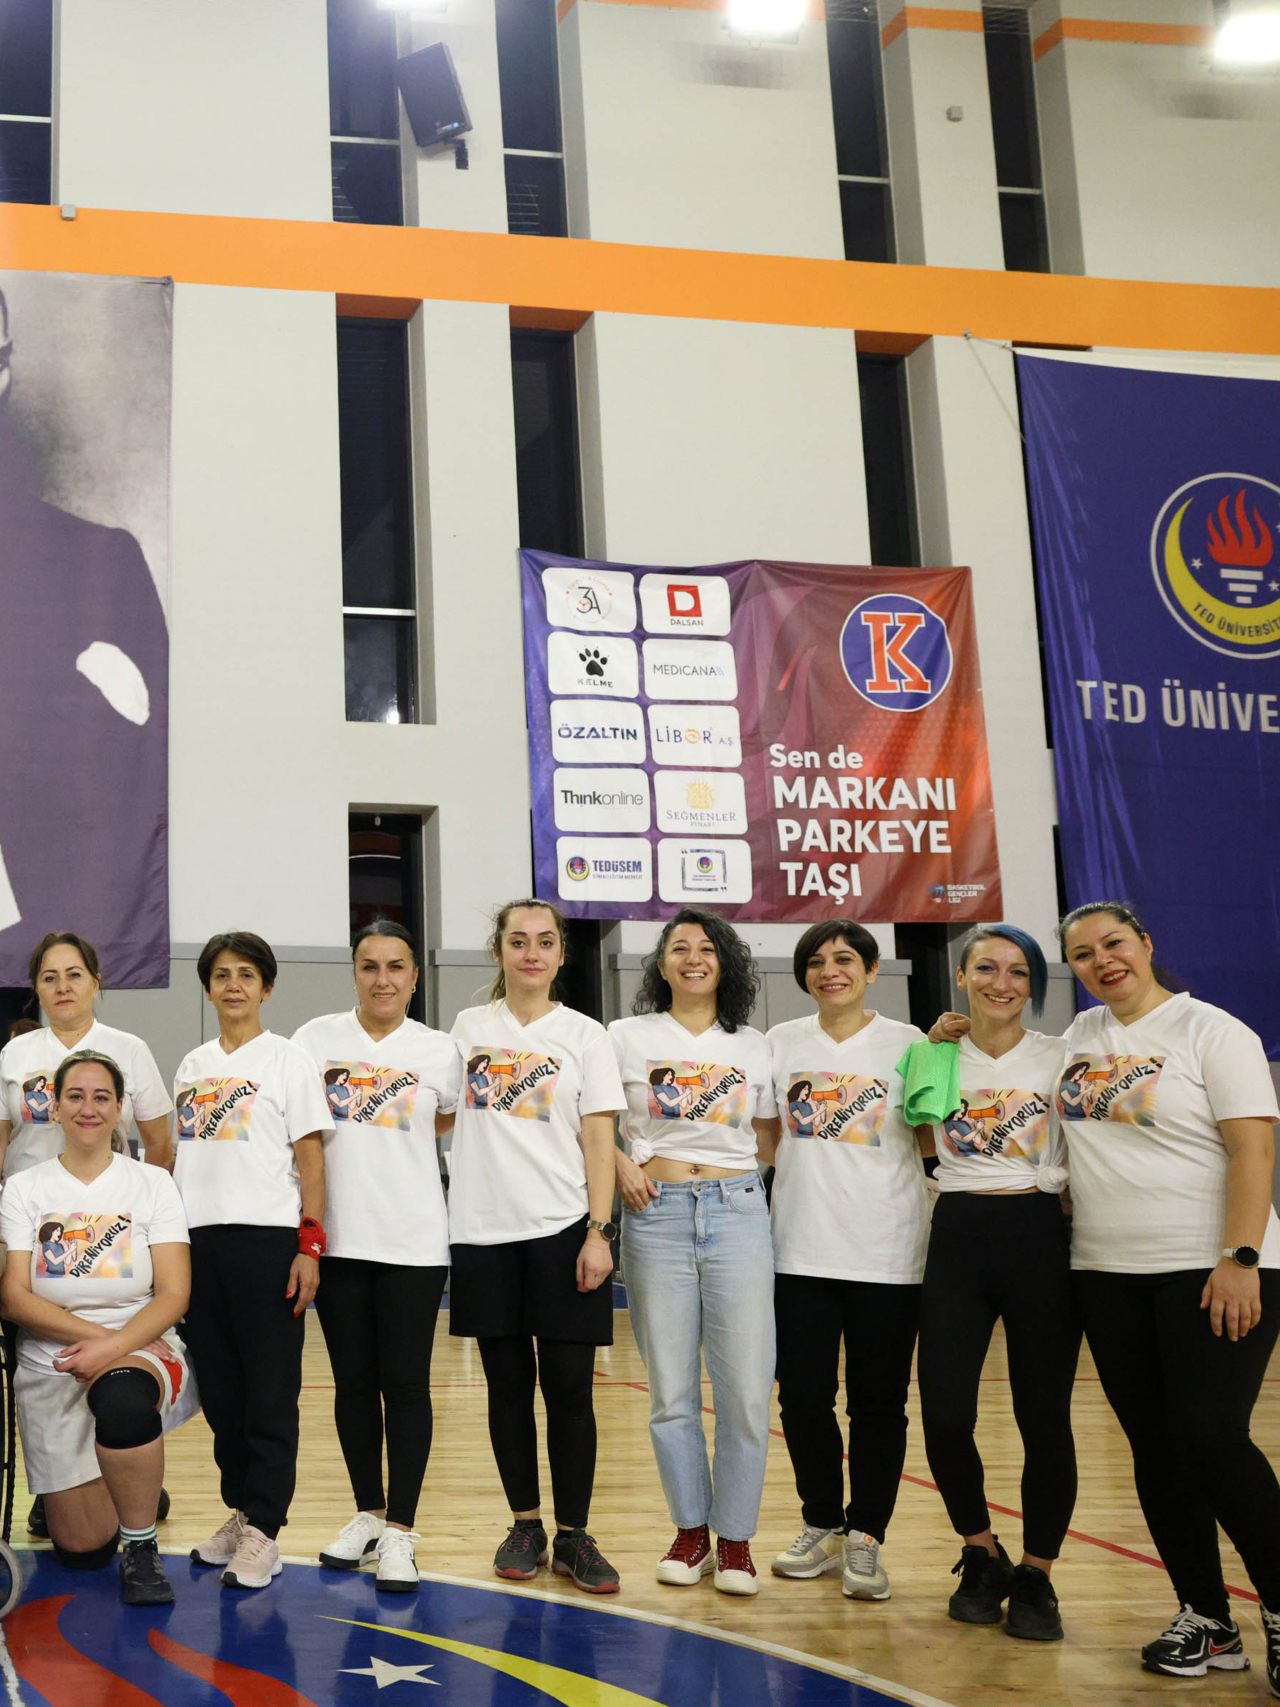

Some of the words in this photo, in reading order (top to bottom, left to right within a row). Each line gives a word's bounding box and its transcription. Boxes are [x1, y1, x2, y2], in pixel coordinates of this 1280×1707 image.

[1193, 602, 1215, 624] TED
[861, 611, 931, 693] K
[577, 679, 613, 688] KELME
[1076, 680, 1147, 724] TED
[558, 724, 637, 740] ÖZALTIN
[770, 743, 820, 768] Sen
[828, 744, 863, 769] de
[773, 775, 956, 810] MARKANI
[777, 819, 952, 853] PARKEYE
[780, 862, 862, 905] TAŞI
